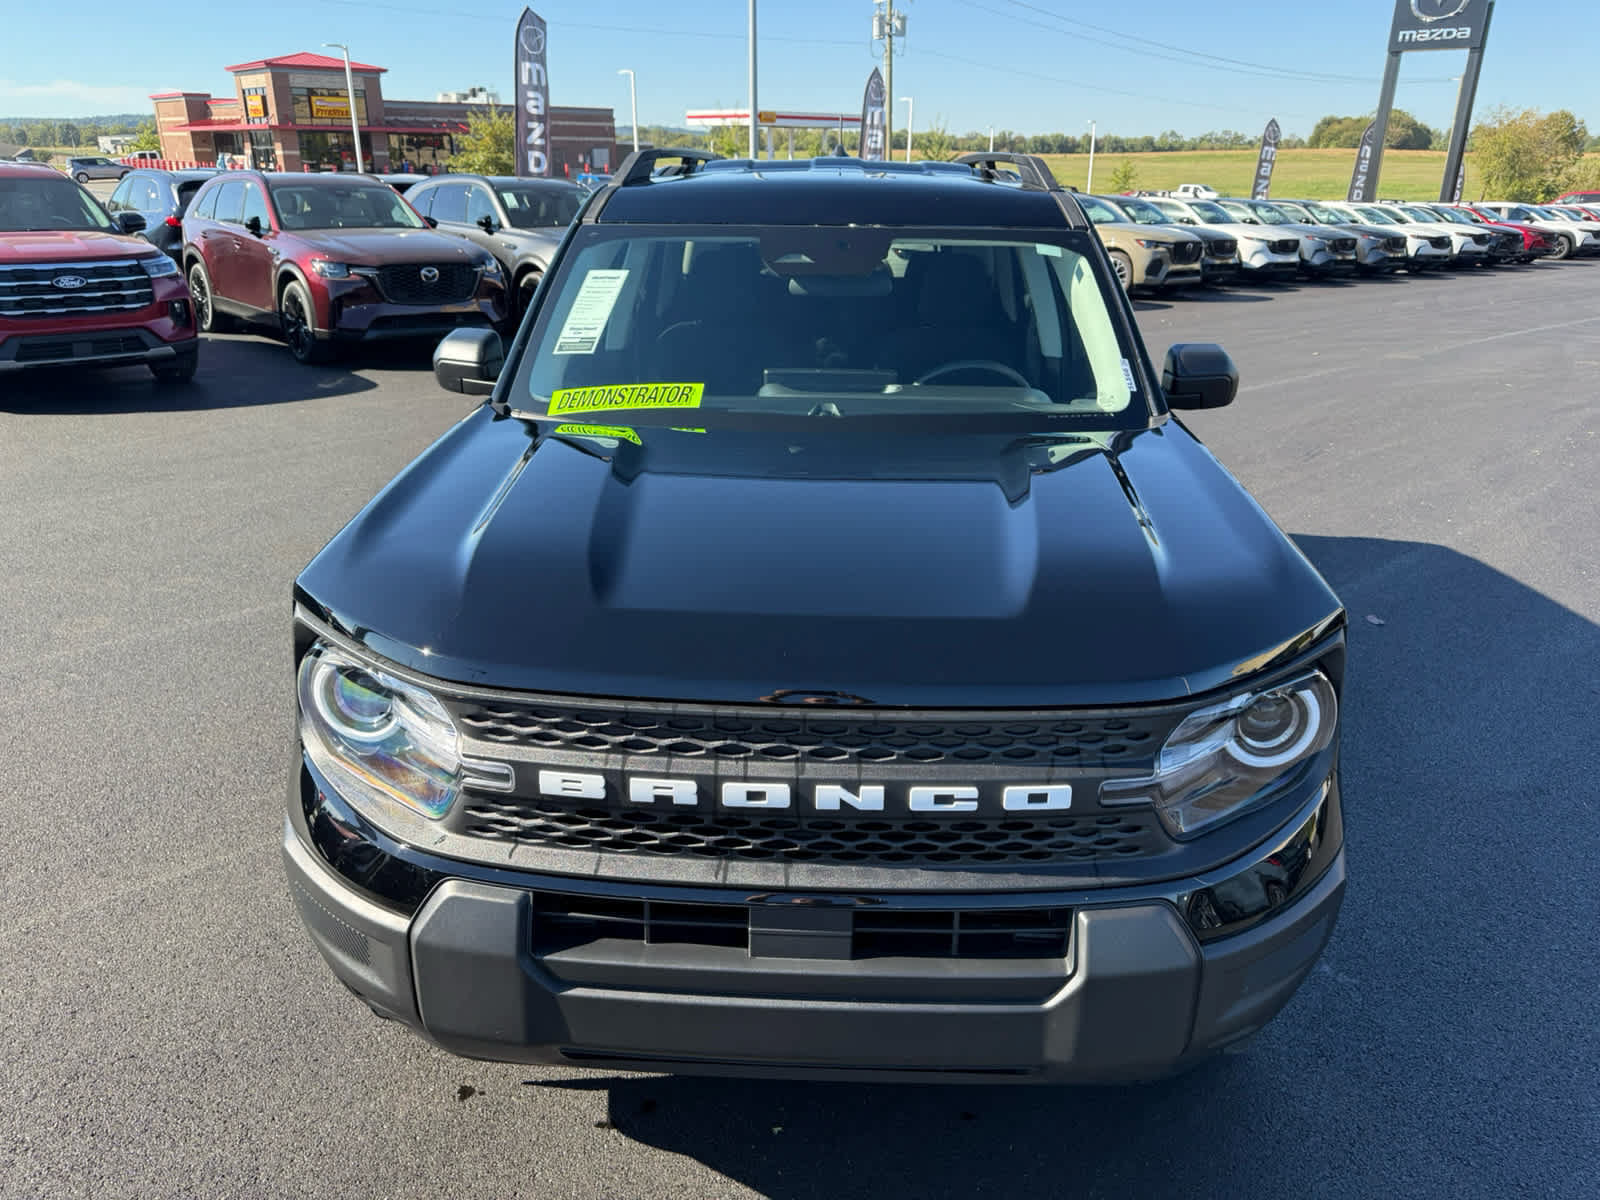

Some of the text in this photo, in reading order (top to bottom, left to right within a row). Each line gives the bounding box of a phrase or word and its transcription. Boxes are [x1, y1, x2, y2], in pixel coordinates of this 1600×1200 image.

[58, 277, 81, 288] Ford
[557, 385, 693, 410] DEMONSTRATOR
[539, 770, 1072, 811] BRONCO
